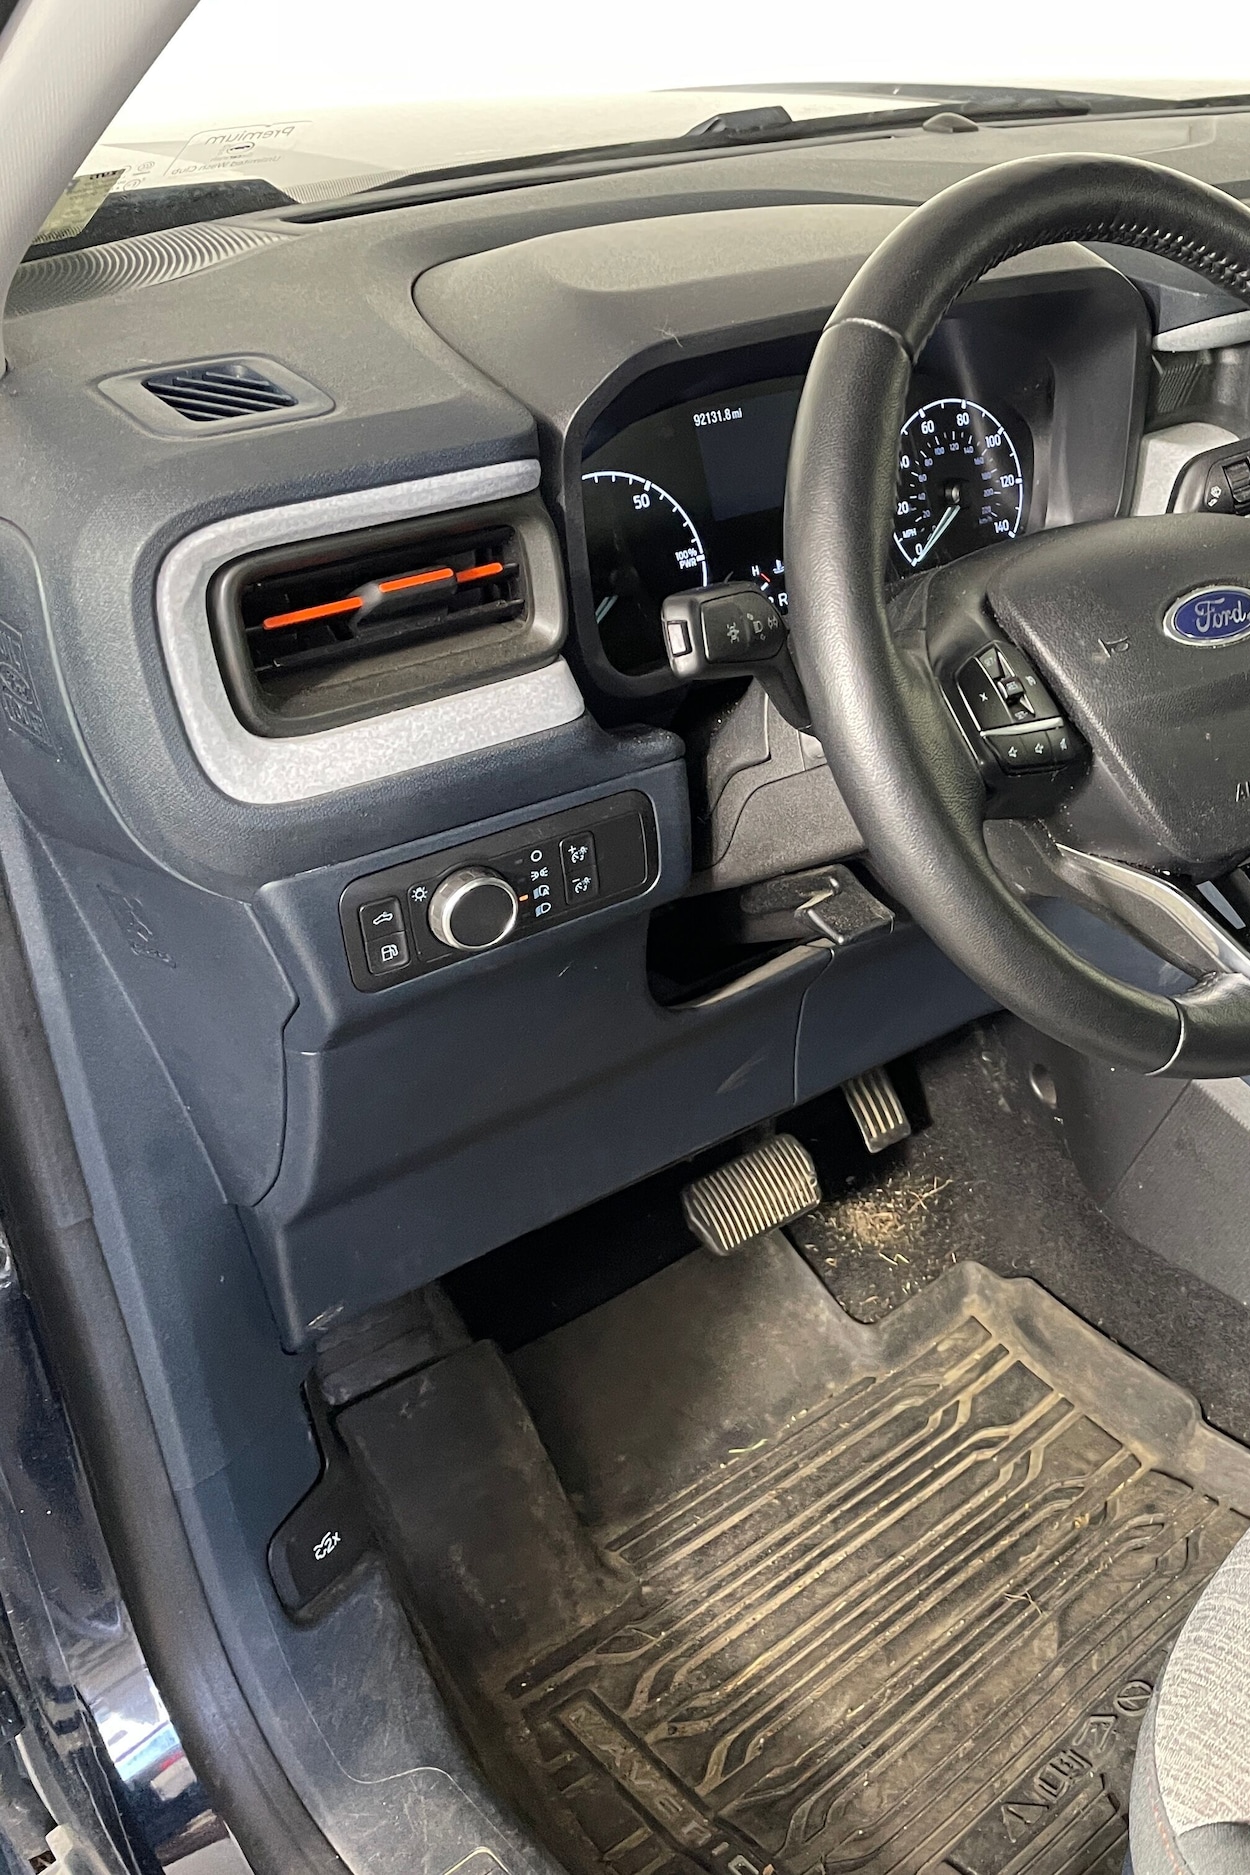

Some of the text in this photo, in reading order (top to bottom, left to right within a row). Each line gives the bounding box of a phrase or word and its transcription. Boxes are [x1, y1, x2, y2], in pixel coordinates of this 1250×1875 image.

[956, 412, 970, 426] 80
[921, 420, 935, 434] 60
[985, 435, 1001, 448] 100
[1000, 474, 1015, 488] 120
[632, 493, 651, 510] 50
[897, 500, 909, 515] 20
[902, 527, 917, 539] MPH
[993, 519, 1010, 533] 140
[675, 547, 698, 562] 100%
[915, 543, 923, 555] 0
[679, 559, 698, 570] PWR
[751, 564, 761, 577] H
[777, 592, 789, 607] R
[1194, 597, 1246, 633] Ford
